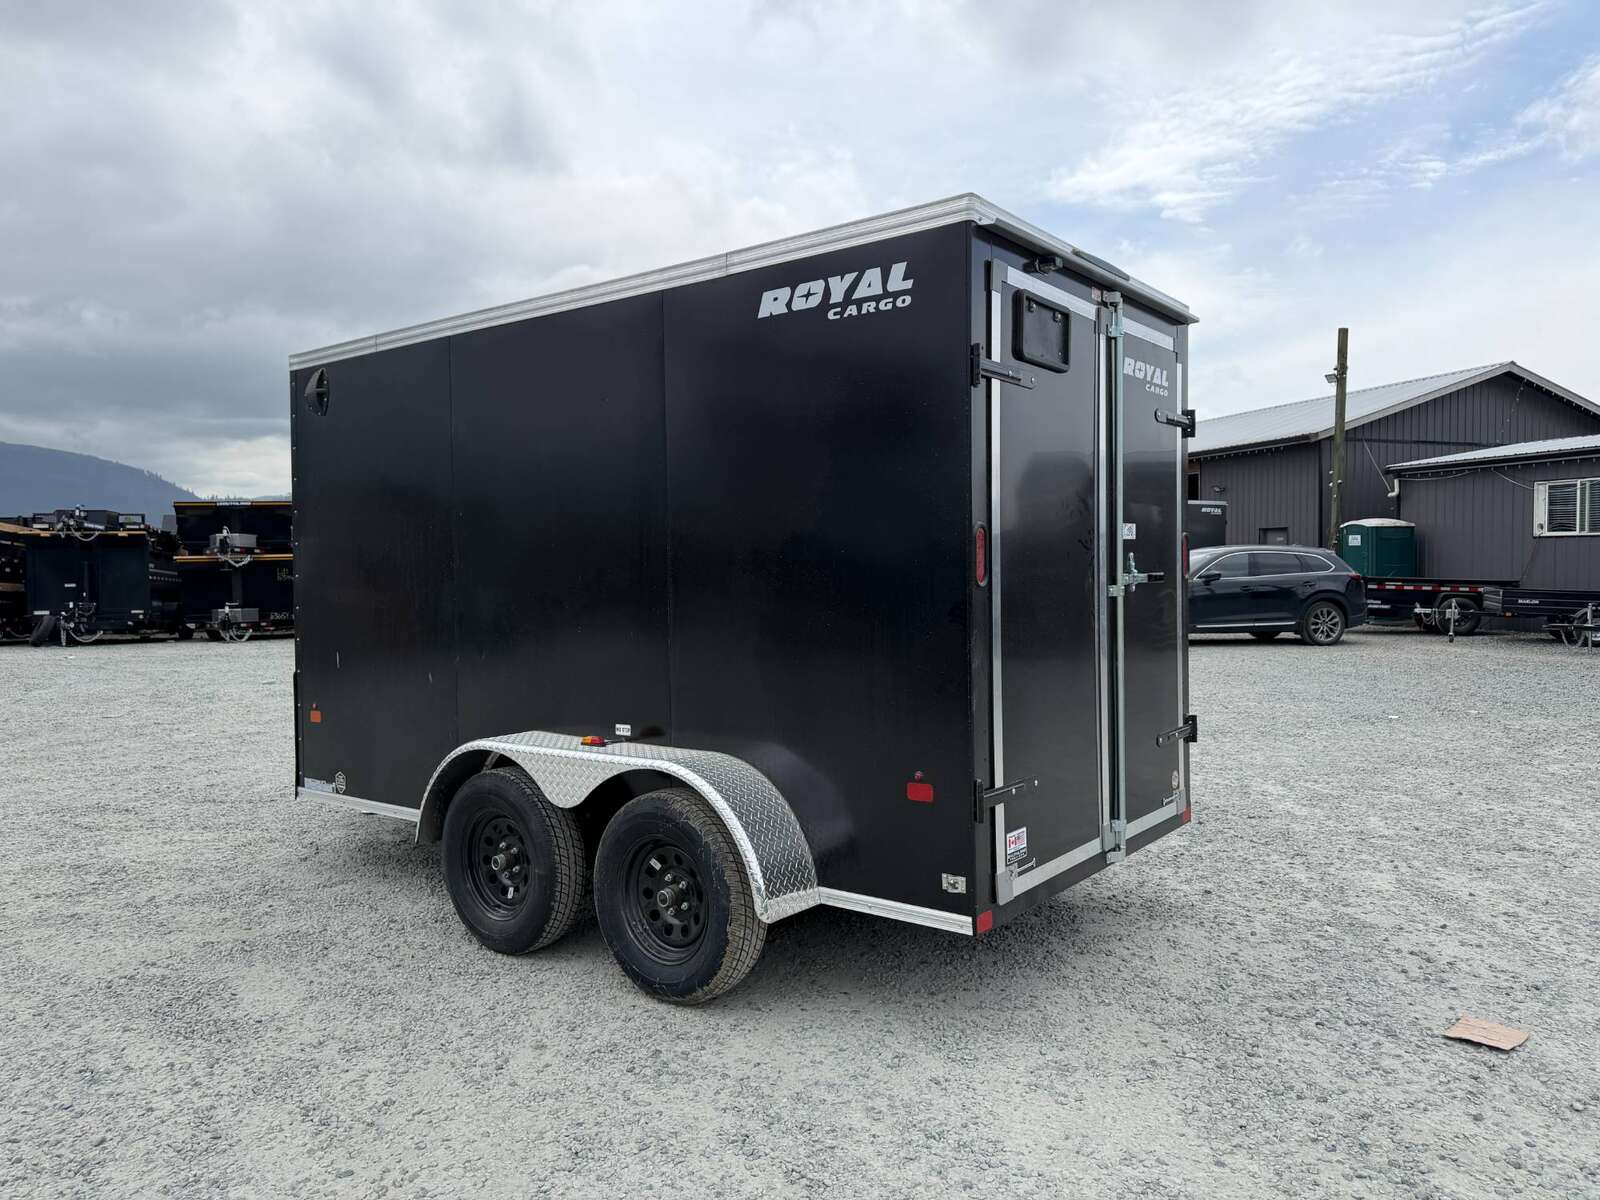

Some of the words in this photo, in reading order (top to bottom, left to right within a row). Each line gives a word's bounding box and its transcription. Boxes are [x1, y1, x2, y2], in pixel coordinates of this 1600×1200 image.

[757, 261, 914, 319] ROYAL
[827, 295, 912, 320] CARGO
[1123, 357, 1168, 386] ROYAL
[1145, 384, 1168, 397] CARGO
